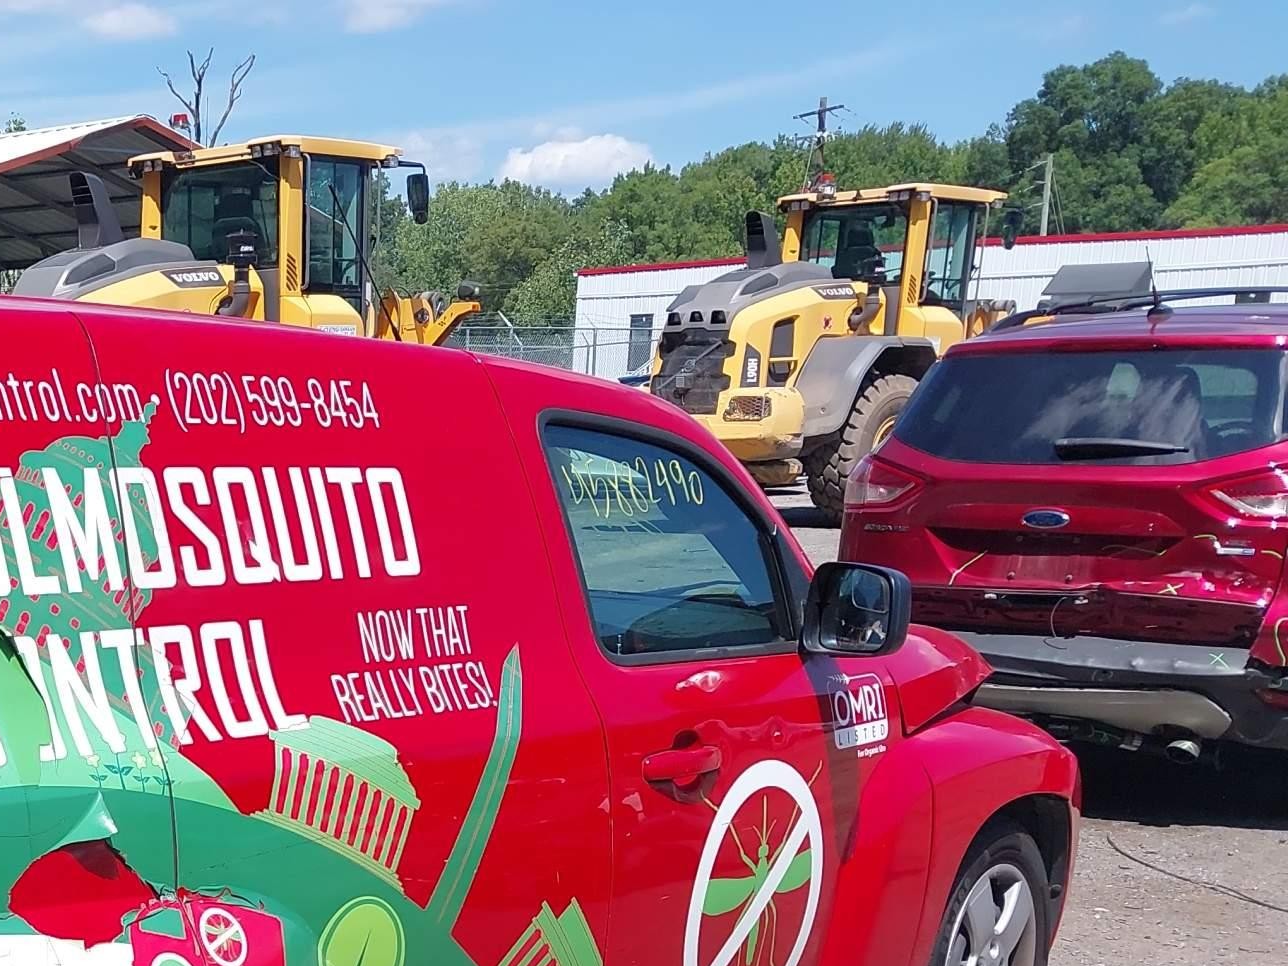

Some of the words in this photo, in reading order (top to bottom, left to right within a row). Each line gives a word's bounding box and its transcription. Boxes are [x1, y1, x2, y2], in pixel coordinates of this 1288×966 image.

[171, 271, 219, 283] VOLVO
[818, 287, 853, 296] VOLVO
[746, 358, 758, 383] L90H
[165, 368, 246, 433] (202)
[244, 375, 381, 429] 599-8454
[357, 609, 415, 664] NOW
[416, 605, 472, 658] THAT
[330, 667, 423, 723] REALLY
[419, 661, 498, 714] BITES!
[834, 683, 885, 726] OMRI
[838, 723, 885, 747] LISTED
